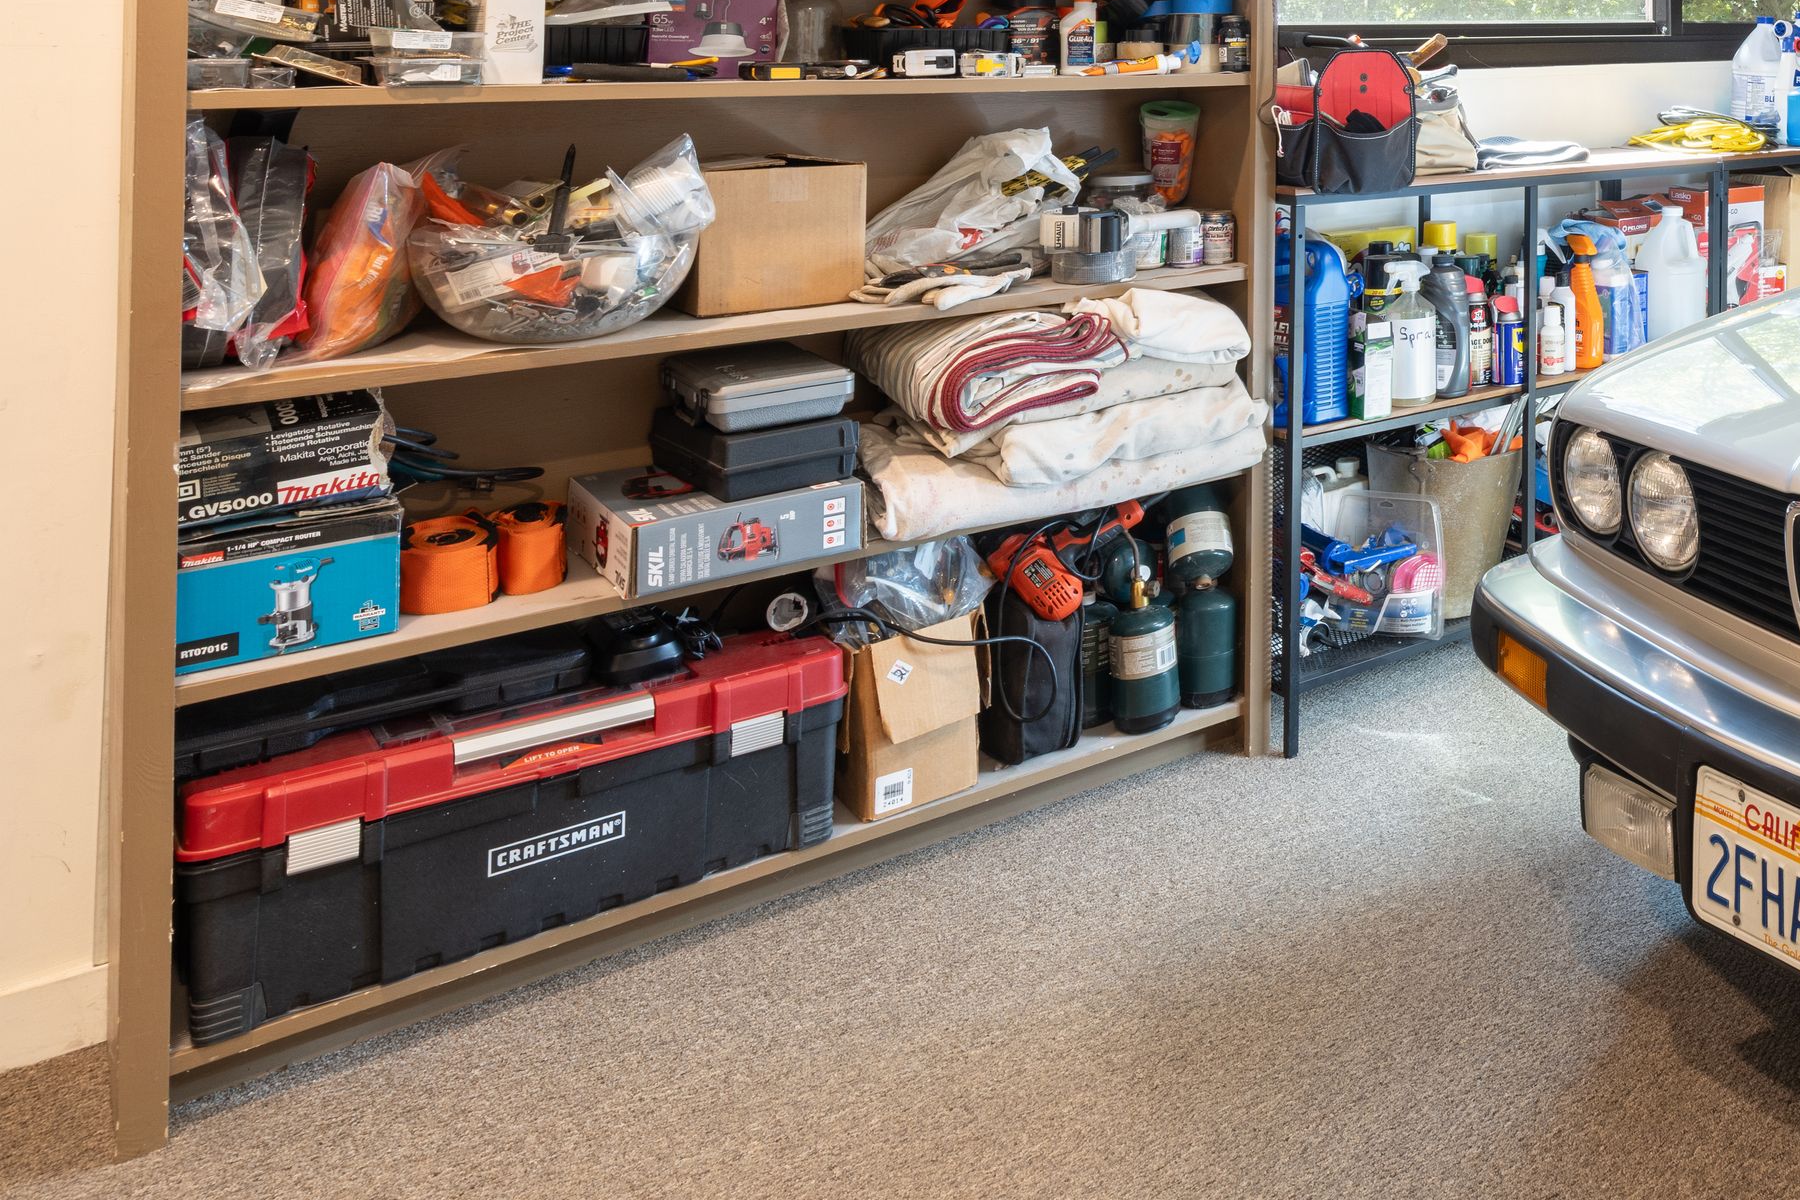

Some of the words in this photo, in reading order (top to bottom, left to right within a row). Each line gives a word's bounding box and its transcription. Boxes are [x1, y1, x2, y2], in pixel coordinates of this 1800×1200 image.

[510, 19, 532, 29] THE
[496, 26, 534, 39] Project
[495, 34, 531, 45] Center
[1670, 191, 1692, 200] Lasko
[1627, 223, 1648, 232] PELONIS
[270, 428, 315, 440] Levigatrice
[317, 421, 351, 431] Rotative
[271, 433, 313, 446] Roterende
[271, 441, 306, 452] Lijadora
[307, 435, 340, 446] Rotativa
[190, 451, 221, 460] Sander
[221, 452, 251, 462] Disque
[280, 450, 315, 463] Makita
[338, 451, 356, 459] Aichi,
[329, 458, 349, 466] Made
[189, 492, 273, 519] GV5000
[226, 542, 246, 552] 1-1/4
[260, 535, 293, 546] COMPACT
[295, 531, 321, 541] ROUTER
[648, 546, 665, 587] SKIL
[180, 642, 228, 660] RT0701C
[524, 754, 543, 763] LIFT
[557, 745, 580, 755] OPEN
[1713, 804, 1734, 820] MONTH
[1763, 933, 1778, 948] The
